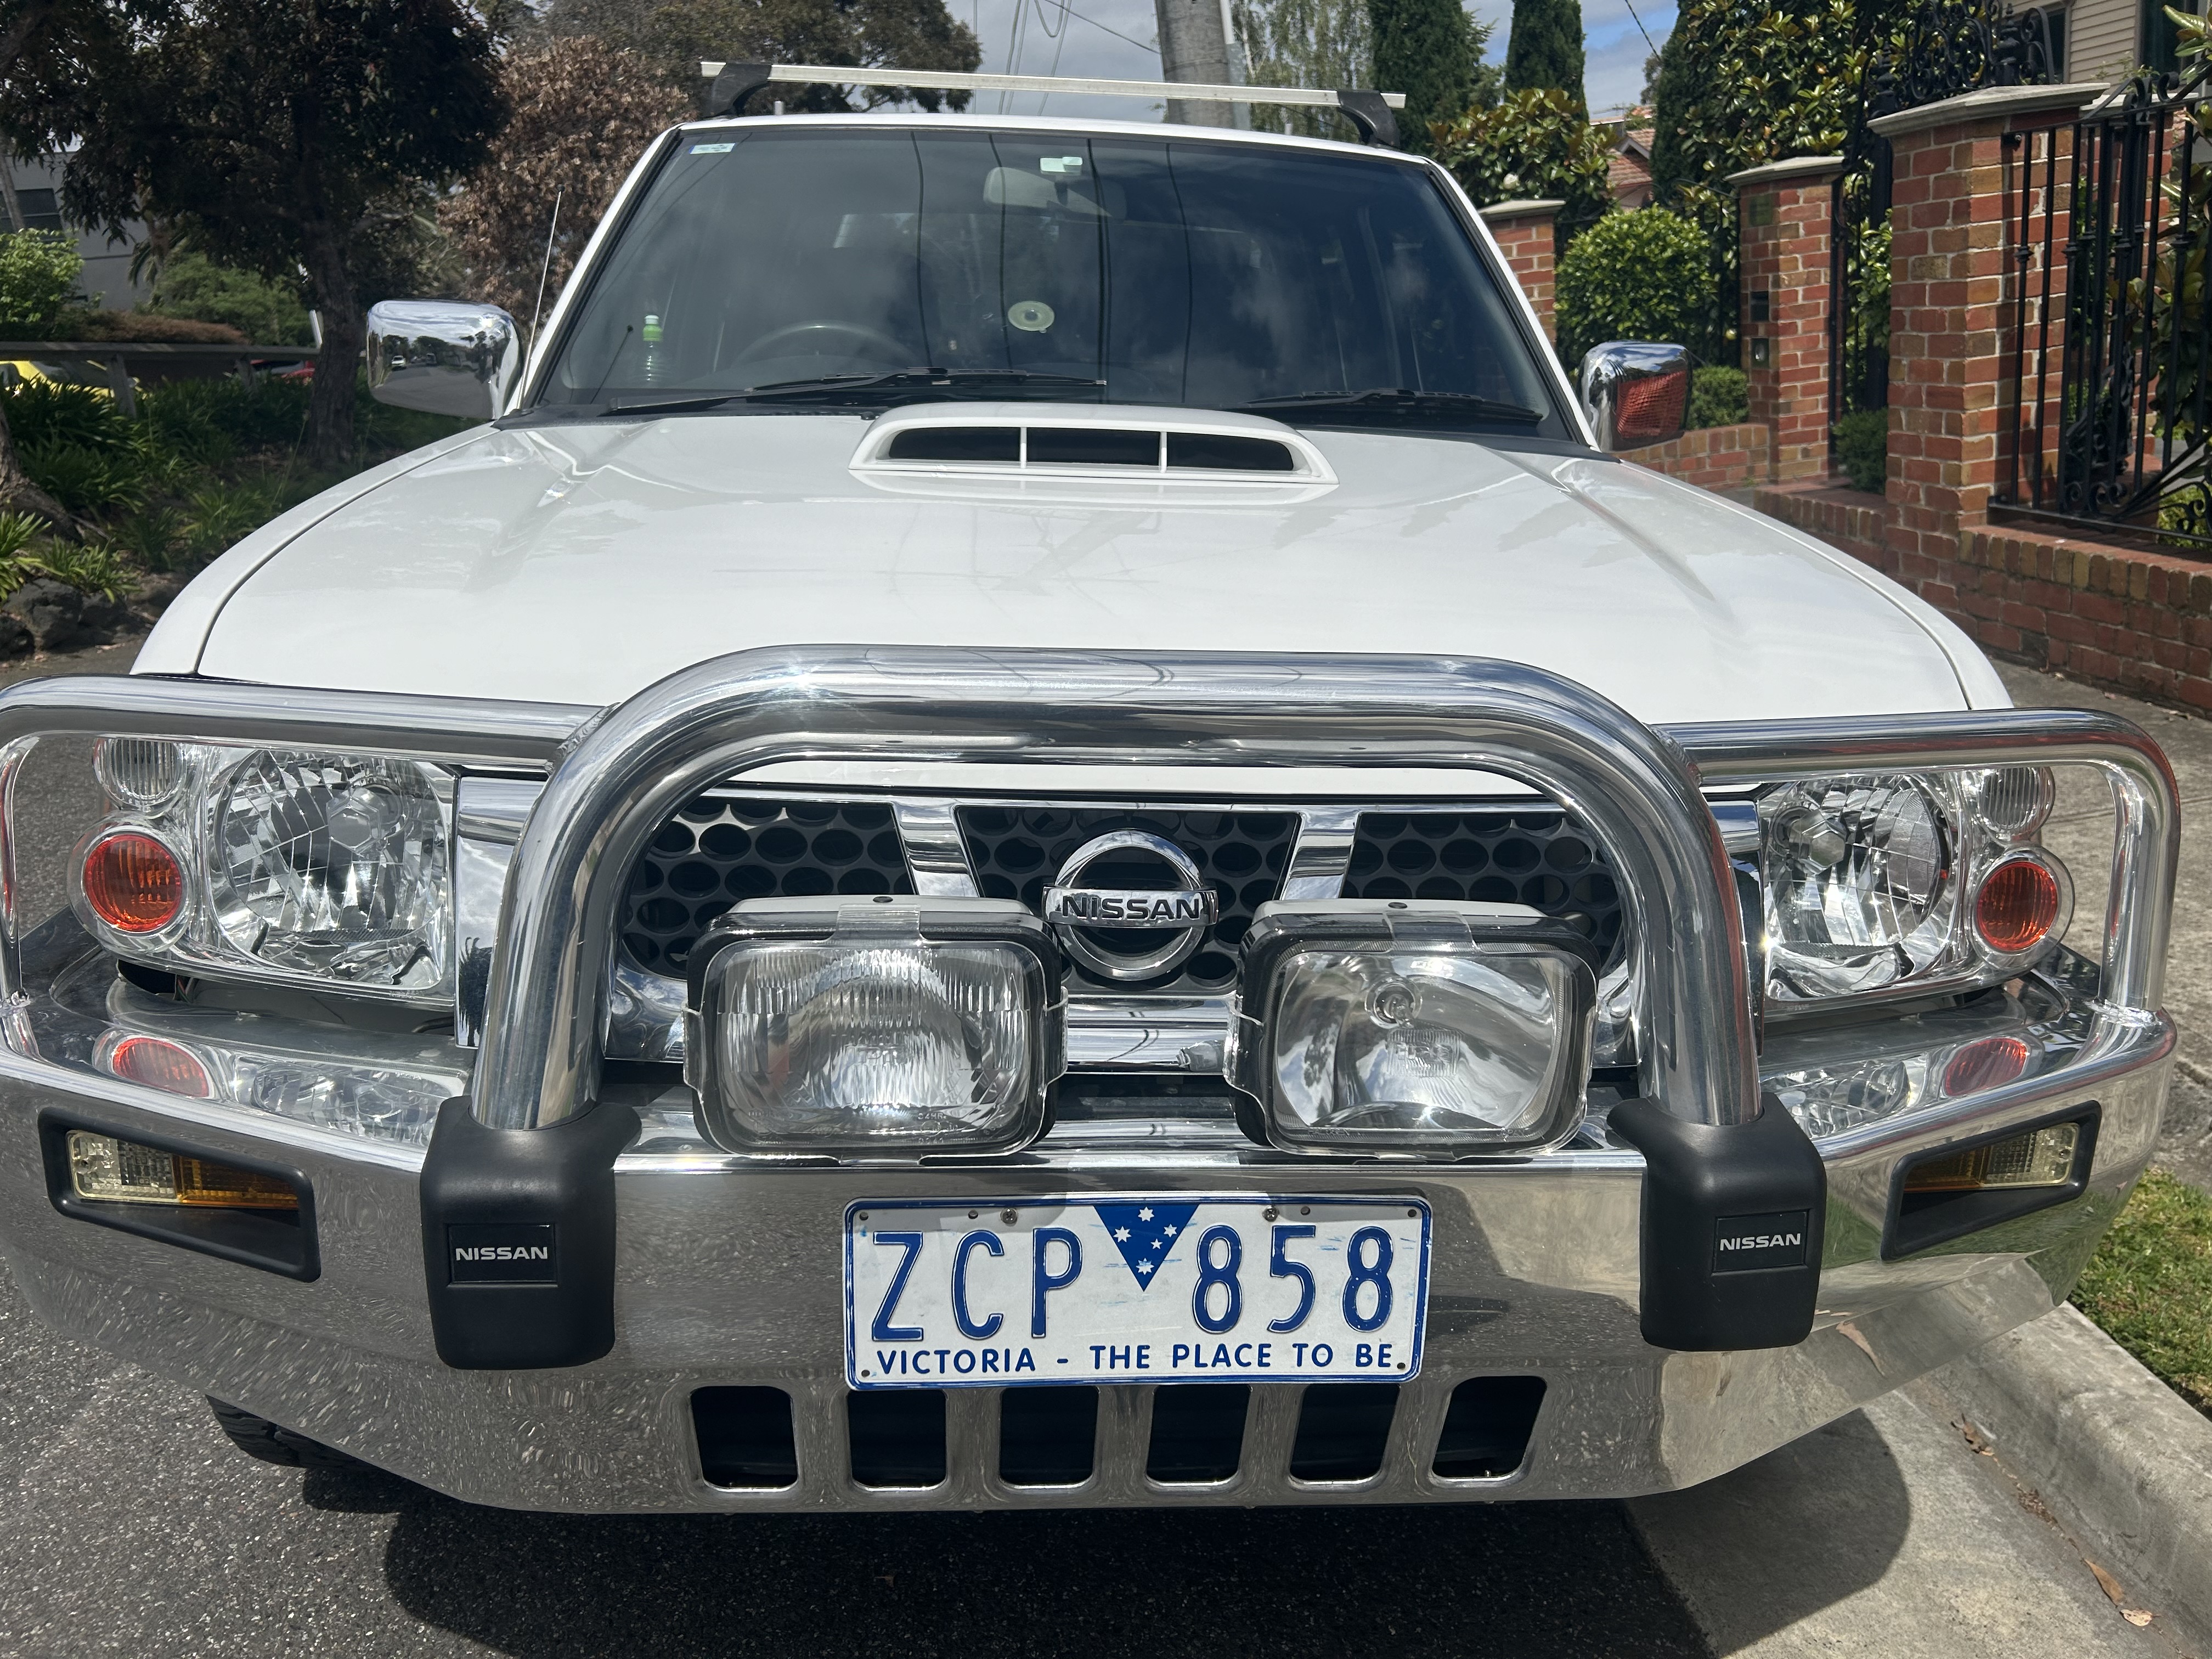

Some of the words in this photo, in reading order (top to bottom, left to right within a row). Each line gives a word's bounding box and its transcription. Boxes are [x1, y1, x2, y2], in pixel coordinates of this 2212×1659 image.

[1062, 895, 1200, 921] NISSAN
[455, 1246, 548, 1261] NISSAN
[1719, 1233, 1801, 1251] NISSAN
[872, 1227, 1083, 1341] ZCP
[1192, 1224, 1394, 1334] 858
[877, 1347, 1036, 1374] VICTORIA
[1089, 1345, 1151, 1369] THE
[1172, 1342, 1272, 1368] PLACE
[1292, 1342, 1334, 1368] TO
[1356, 1343, 1393, 1368] BE
